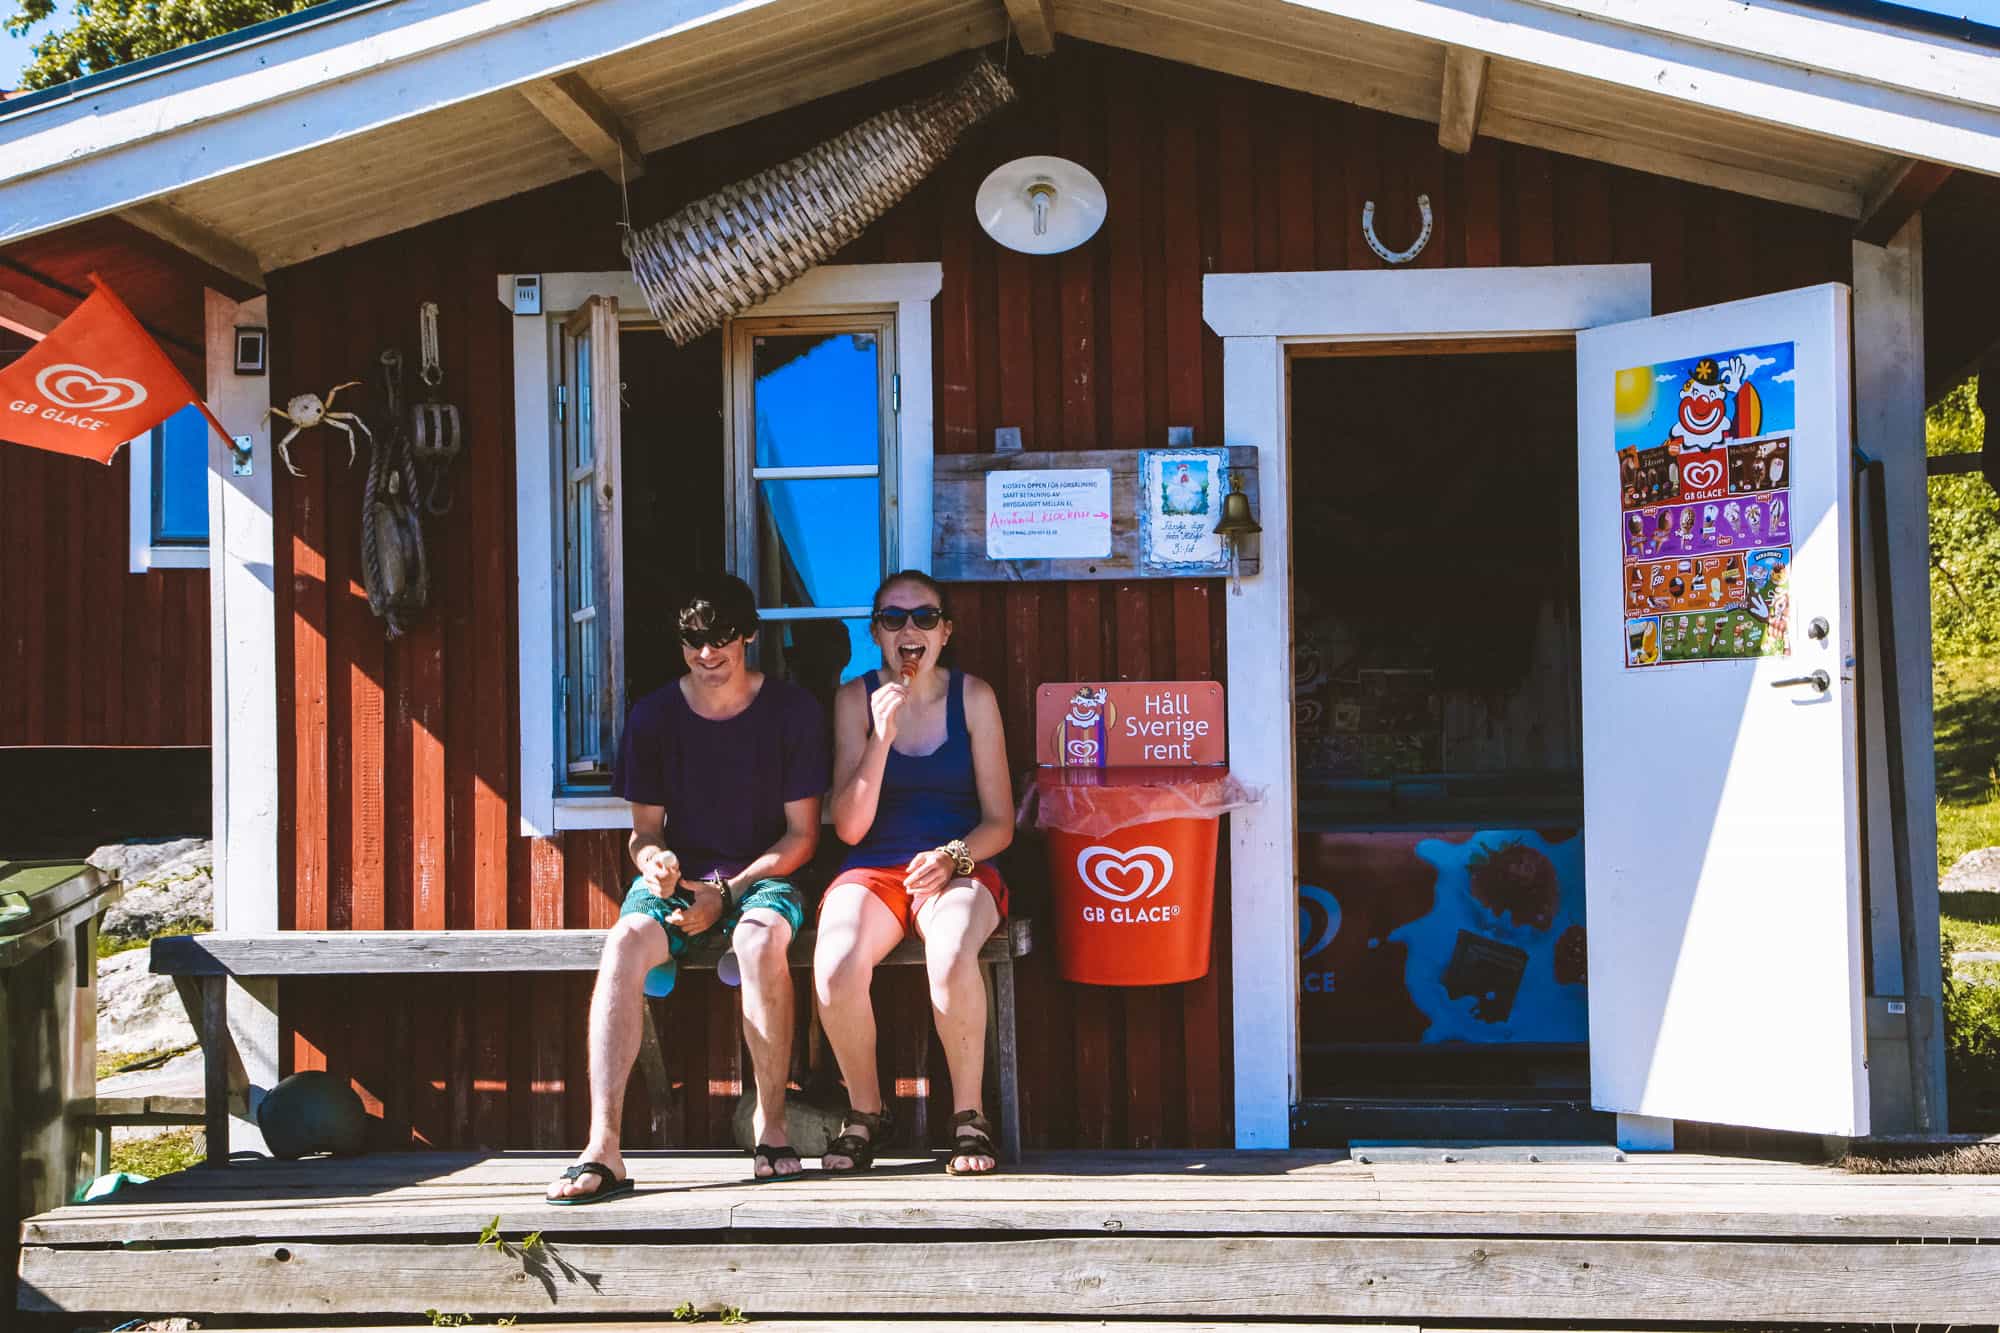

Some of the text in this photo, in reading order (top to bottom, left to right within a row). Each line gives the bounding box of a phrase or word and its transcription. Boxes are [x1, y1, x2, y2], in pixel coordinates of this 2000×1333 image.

[9, 400, 38, 414] GB
[1027, 481, 1047, 489] ÖPPEN
[1684, 492, 1695, 500] GB
[1144, 691, 1190, 715] Håll
[1126, 716, 1209, 740] Sverige
[1144, 740, 1193, 760] rent
[1082, 906, 1105, 922] GB
